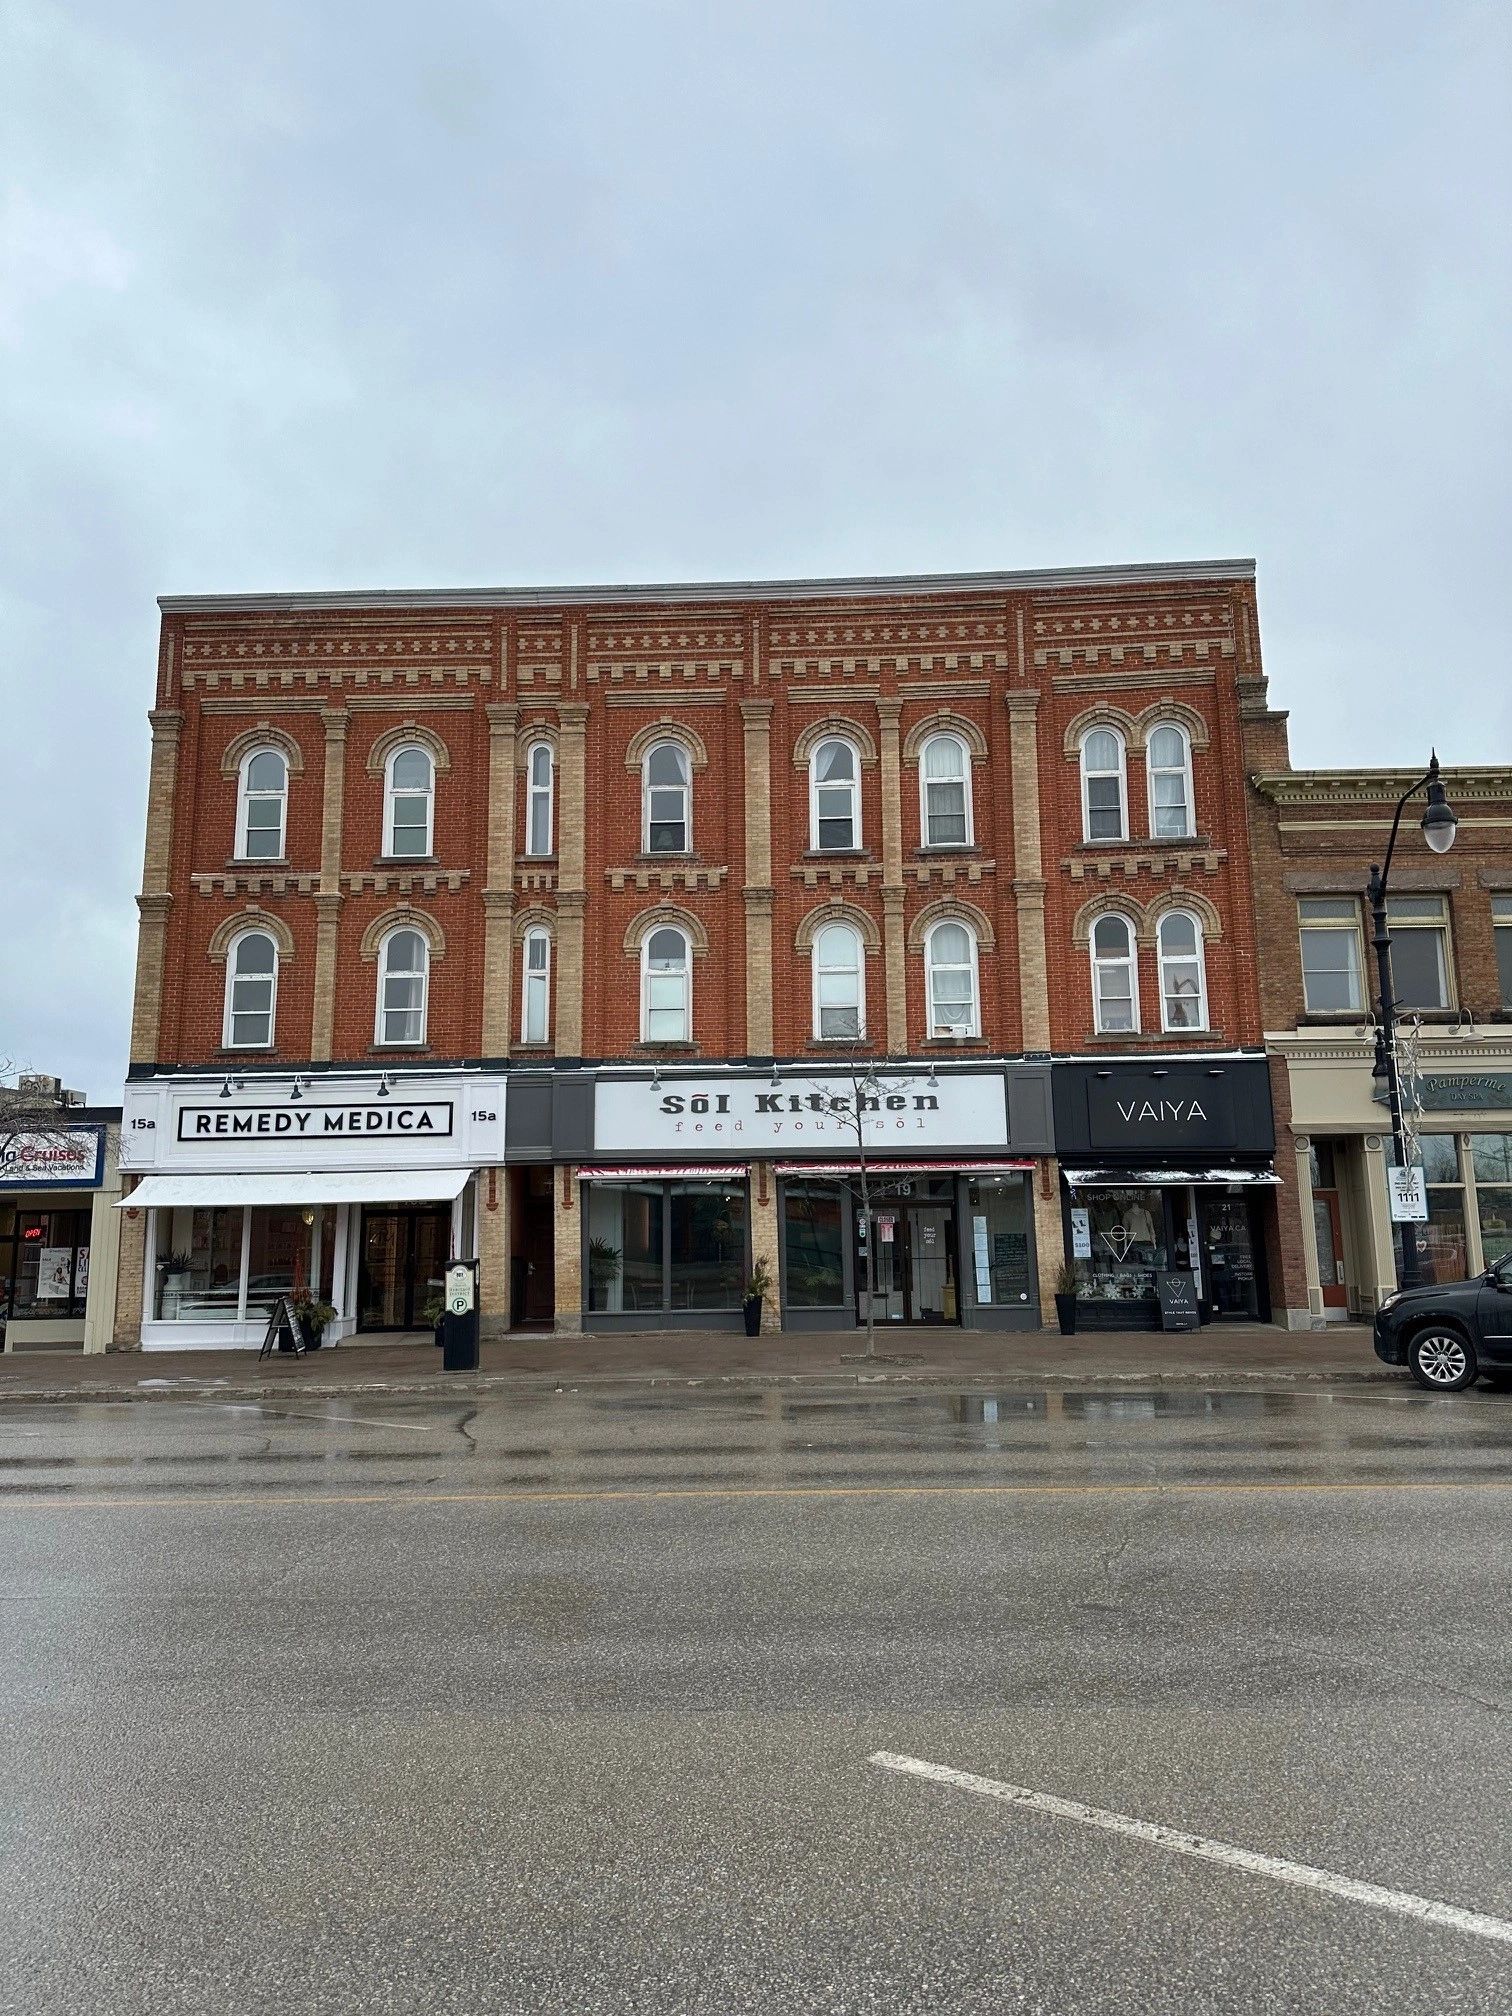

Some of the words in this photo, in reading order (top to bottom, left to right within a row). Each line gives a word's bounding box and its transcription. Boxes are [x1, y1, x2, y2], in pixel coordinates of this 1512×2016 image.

[754, 1092, 940, 1114] Kitchen
[471, 1110, 497, 1122] 15a
[1116, 1100, 1207, 1121] VAIYA
[130, 1118, 156, 1129] 15a
[196, 1113, 312, 1134] REMEDY
[324, 1110, 434, 1131] MEDICA
[675, 1120, 744, 1132] feed
[773, 1119, 847, 1133] your
[21, 1145, 85, 1162] Cruises
[896, 1182, 911, 1196] 19
[1086, 1193, 1112, 1201] SHOP
[1397, 1192, 1419, 1202] 1111
[1221, 1203, 1231, 1211] 21
[25, 1228, 41, 1238] OPEN
[456, 1301, 464, 1310] P
